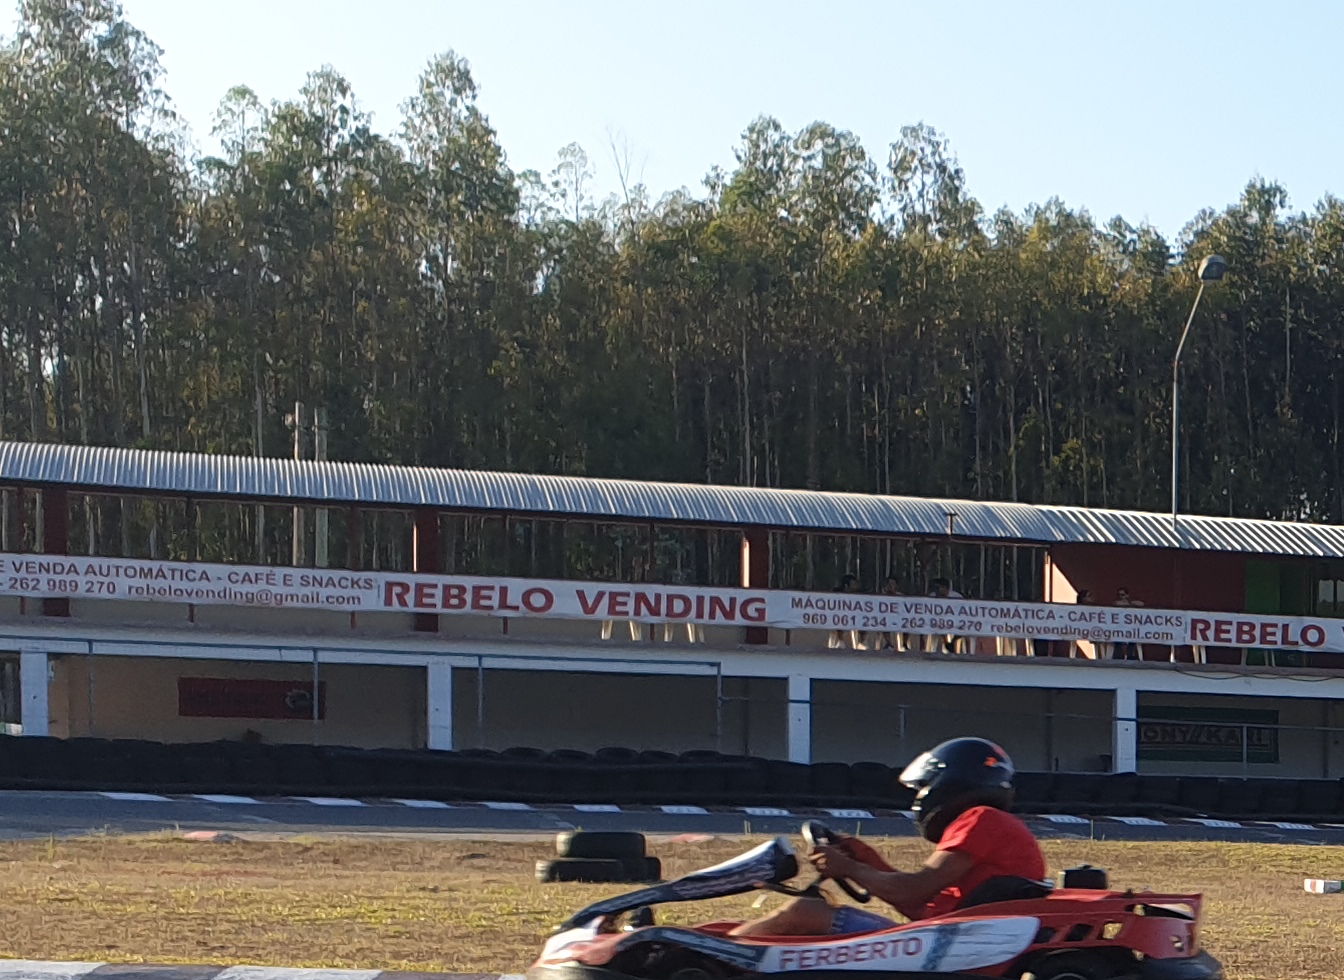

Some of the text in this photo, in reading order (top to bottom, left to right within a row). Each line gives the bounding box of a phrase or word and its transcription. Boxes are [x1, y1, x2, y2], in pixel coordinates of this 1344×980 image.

[8, 576, 41, 592] 262
[84, 580, 117, 595] 270
[12, 560, 80, 576] VENDA
[84, 563, 211, 584] AUTOMÁTICA
[227, 570, 277, 586] CAFÉ
[282, 573, 294, 587] E
[300, 574, 374, 590] SNACKS
[384, 580, 767, 623] REBELO VENDING
[791, 595, 874, 614] MÁQUINAS
[879, 602, 899, 614] DE
[904, 602, 956, 617] VENDA
[958, 605, 1056, 621] AUTOMÁTICA
[1067, 609, 1108, 624] CAFÉ
[1111, 613, 1120, 625] E
[1124, 613, 1183, 628] SNACKS
[802, 612, 828, 625] 969
[832, 614, 856, 627] 061
[862, 616, 888, 628] 234
[901, 617, 924, 629] 262
[958, 619, 983, 632] 270
[1190, 617, 1326, 648] REBELO
[779, 936, 923, 970] FERBERTO
